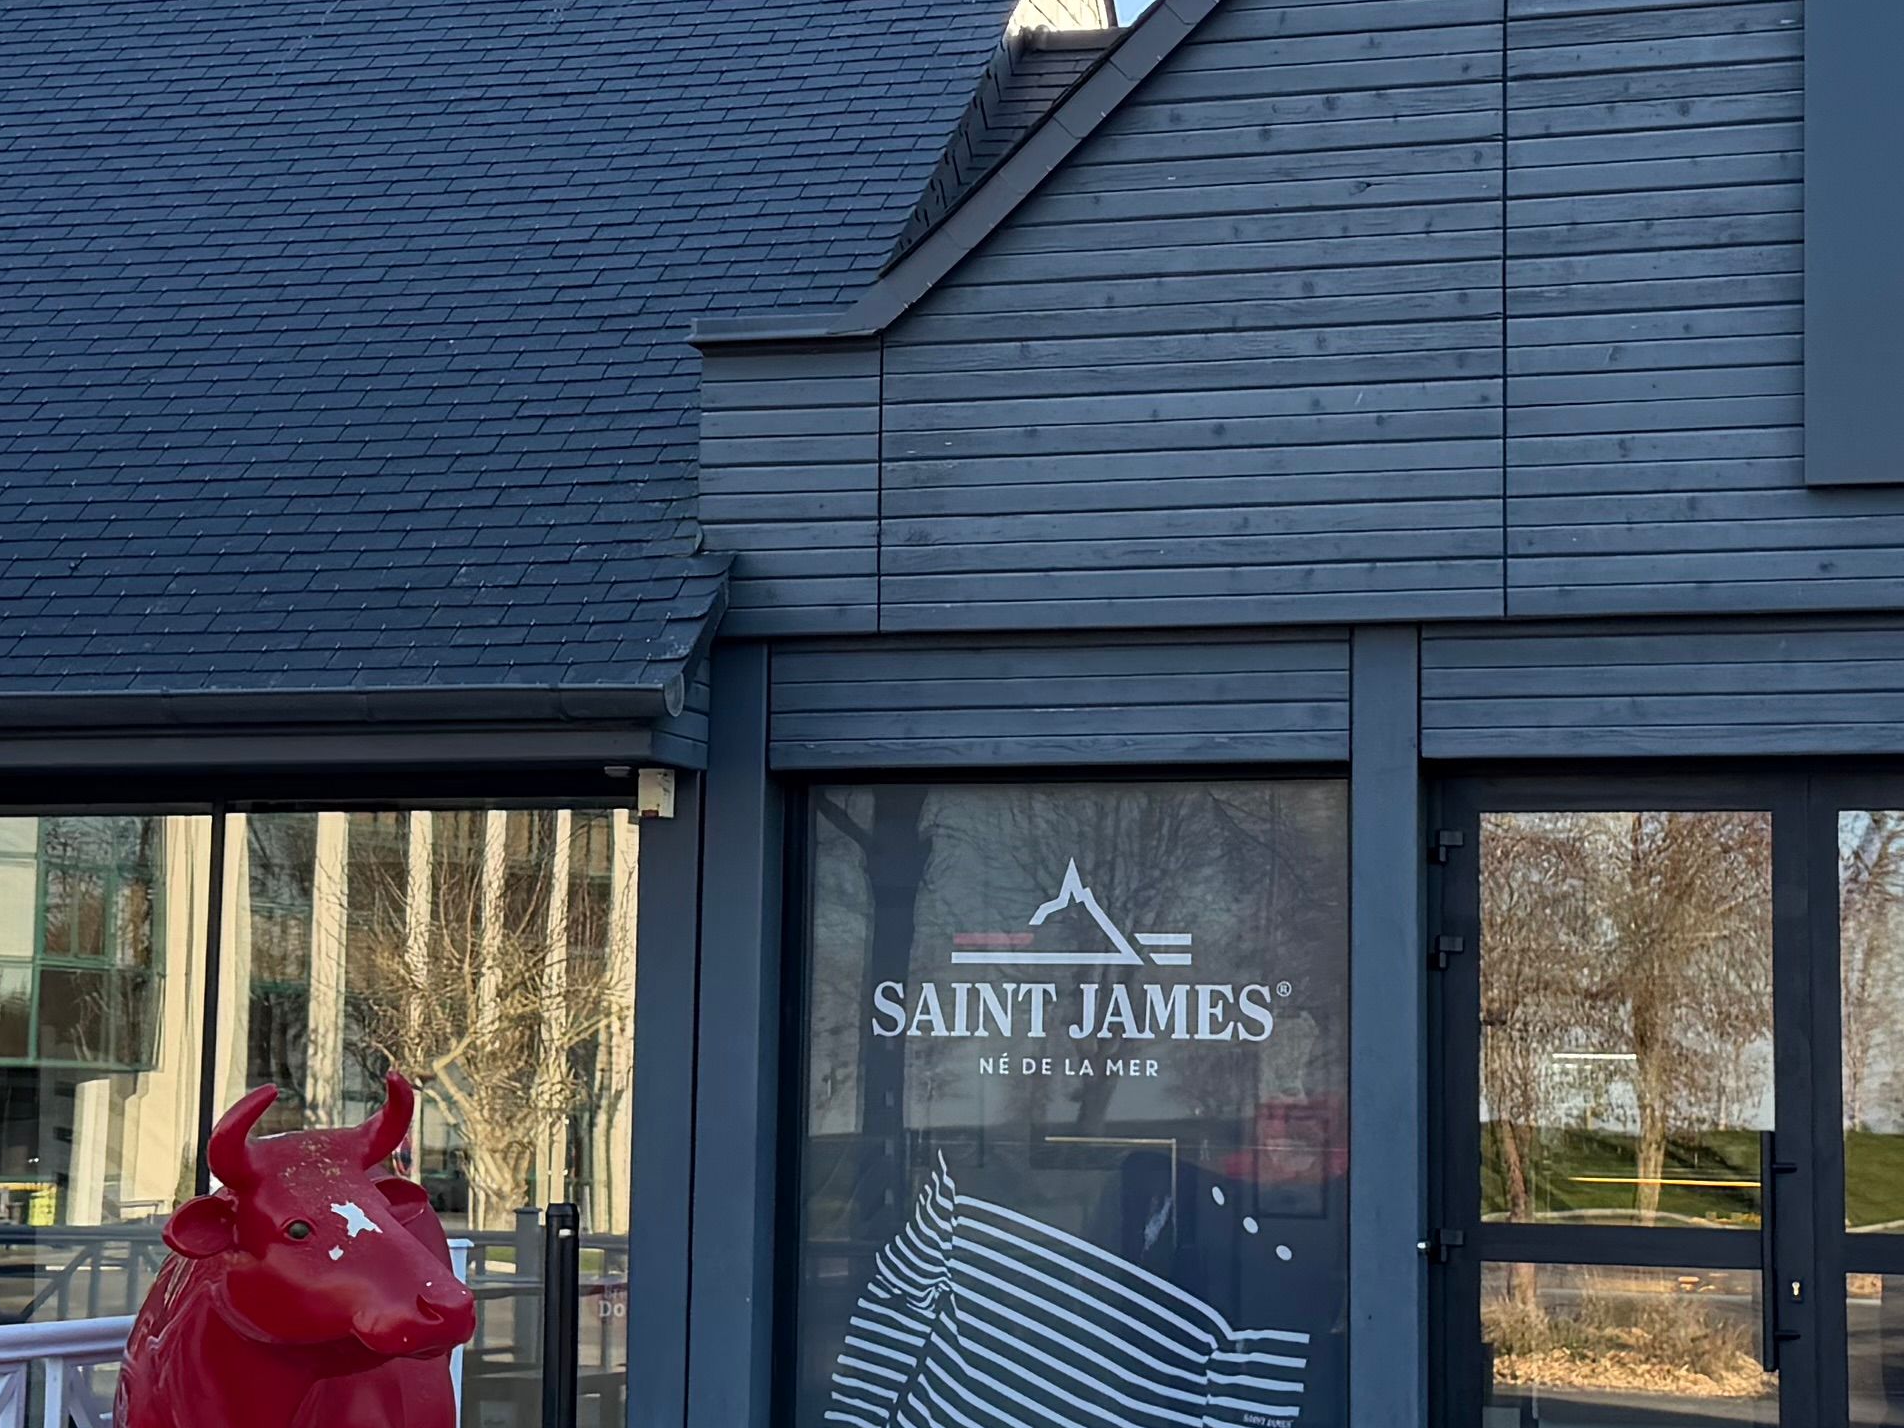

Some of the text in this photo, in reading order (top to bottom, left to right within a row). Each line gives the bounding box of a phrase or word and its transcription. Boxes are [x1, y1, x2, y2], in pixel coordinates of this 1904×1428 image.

[872, 981, 1057, 1039] SAINT
[979, 1053, 1158, 1078] NÉ DE LA MER
